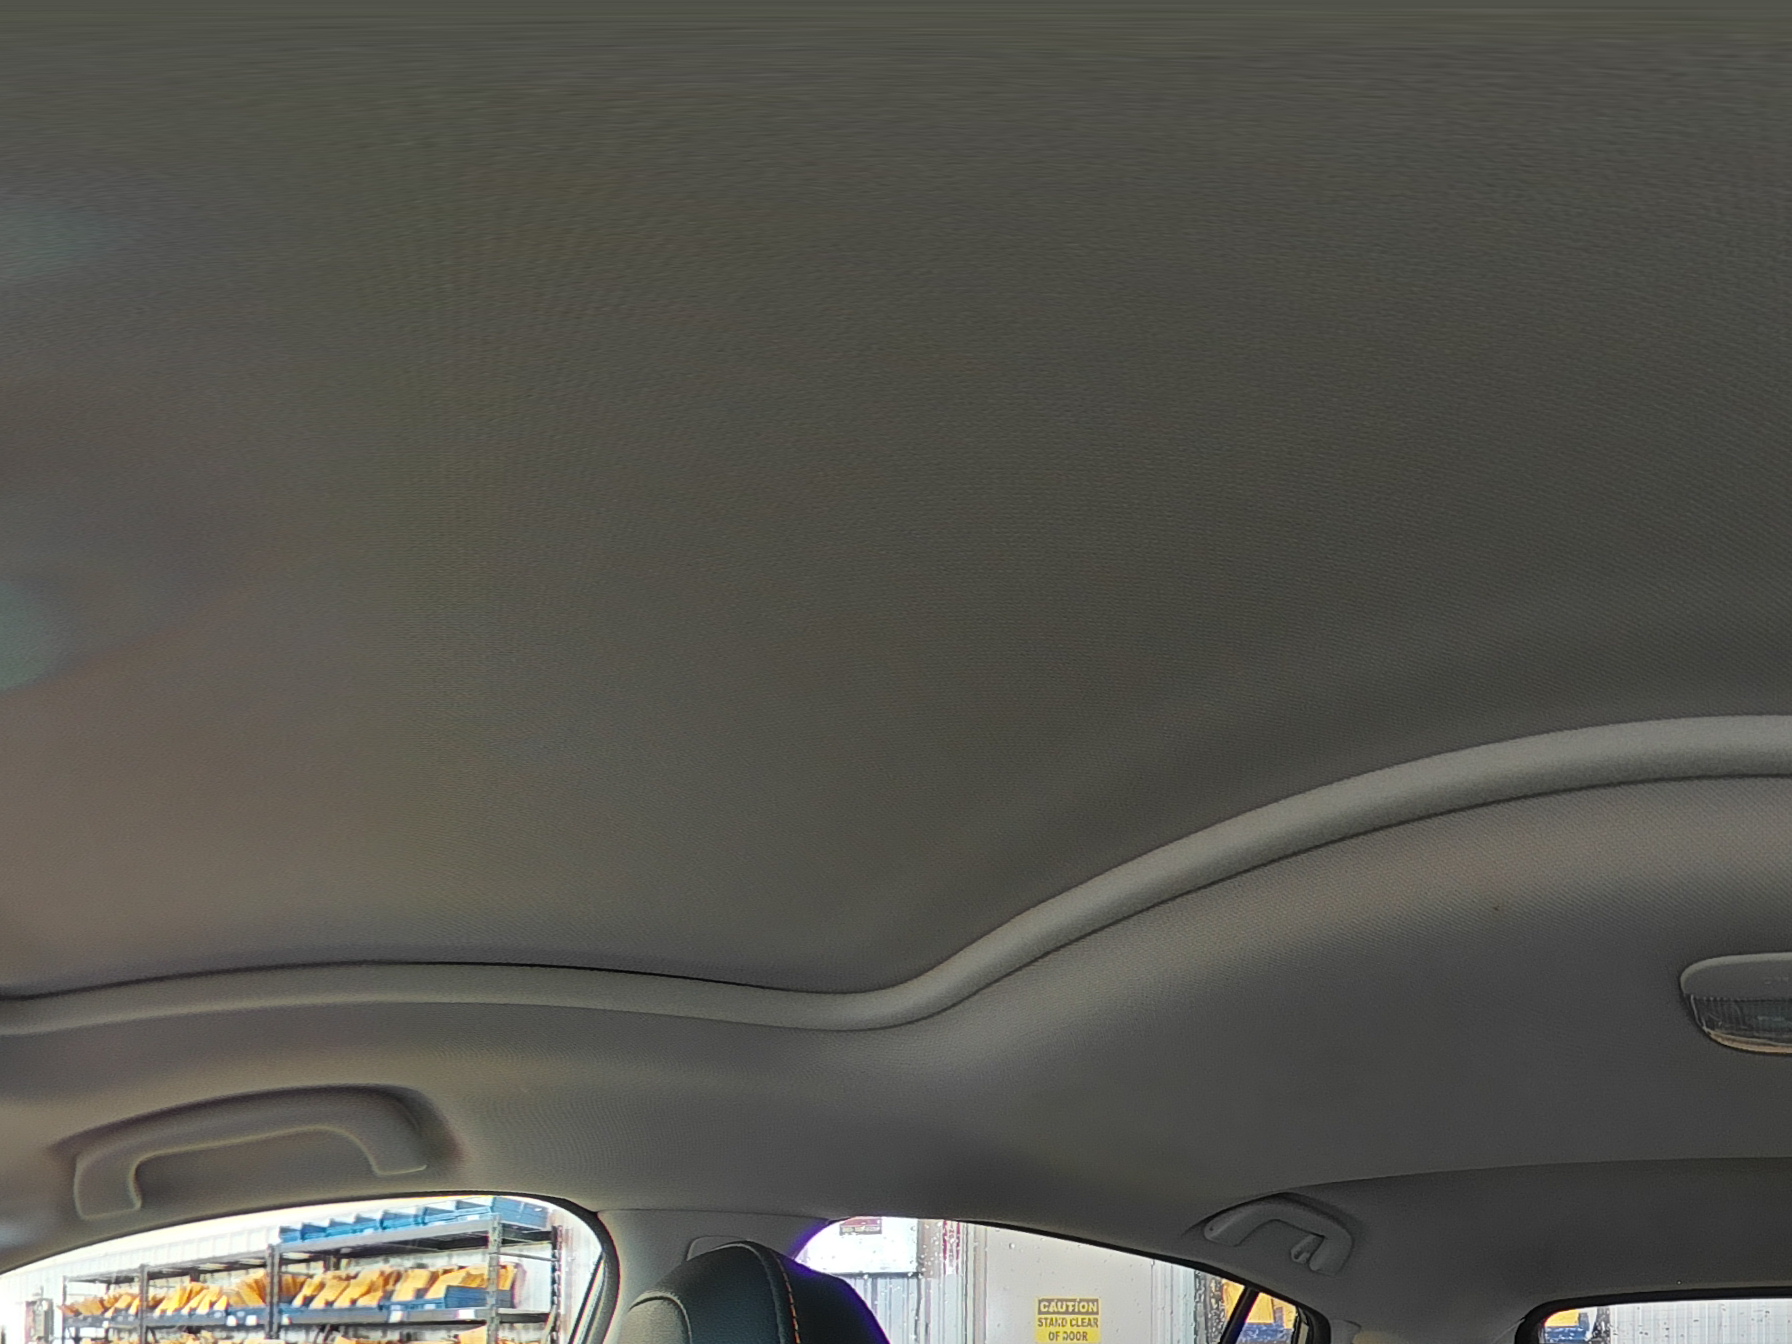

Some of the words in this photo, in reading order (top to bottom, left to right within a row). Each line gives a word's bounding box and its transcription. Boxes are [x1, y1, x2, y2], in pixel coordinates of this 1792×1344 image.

[1039, 1301, 1097, 1313] CAUTION
[1037, 1317, 1067, 1328] STAND
[1069, 1317, 1099, 1329] CLEAR
[1048, 1331, 1061, 1341] OF
[1062, 1331, 1089, 1342] DOOR
